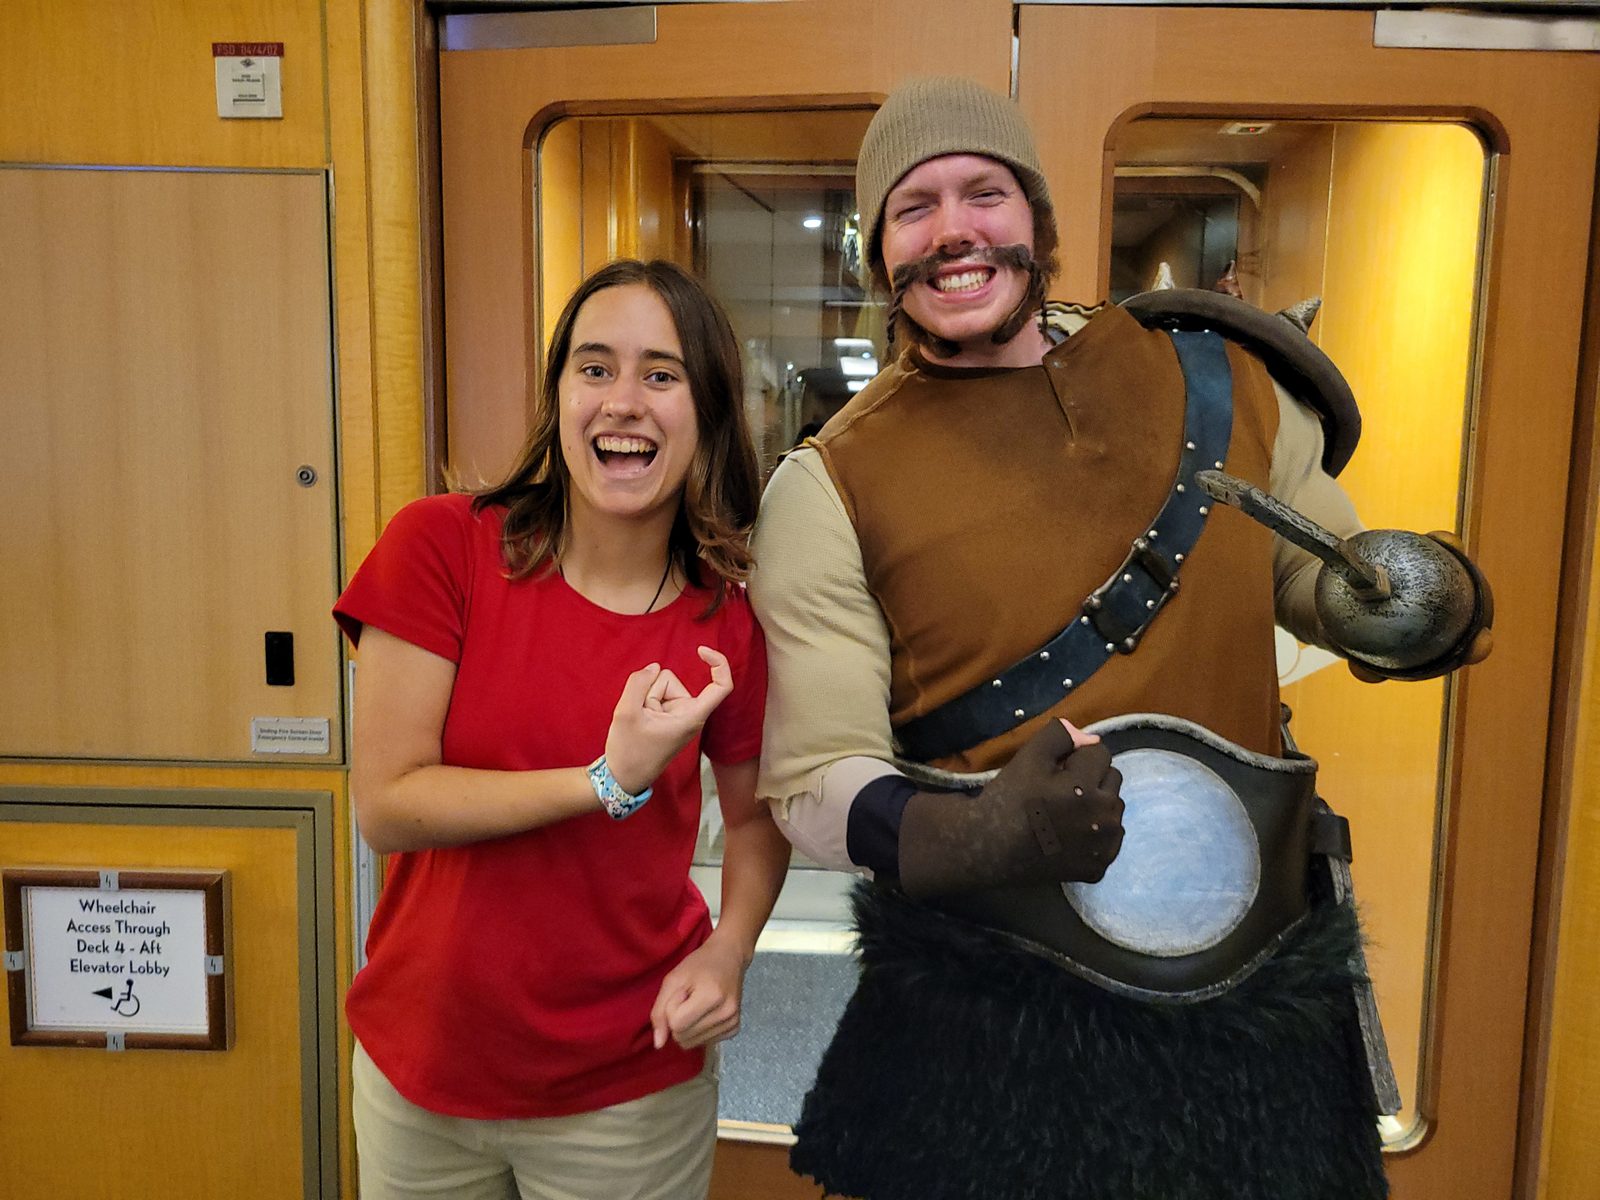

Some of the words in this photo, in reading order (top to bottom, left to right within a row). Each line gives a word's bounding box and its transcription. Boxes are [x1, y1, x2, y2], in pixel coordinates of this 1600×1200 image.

[79, 898, 157, 915] Wheelchair
[66, 918, 111, 934] Access
[115, 919, 171, 938] Through
[77, 939, 110, 954] Deck
[114, 940, 126, 955] 4
[139, 940, 162, 955] Aft
[69, 958, 125, 975] Elevator
[129, 959, 170, 978] Lobby
